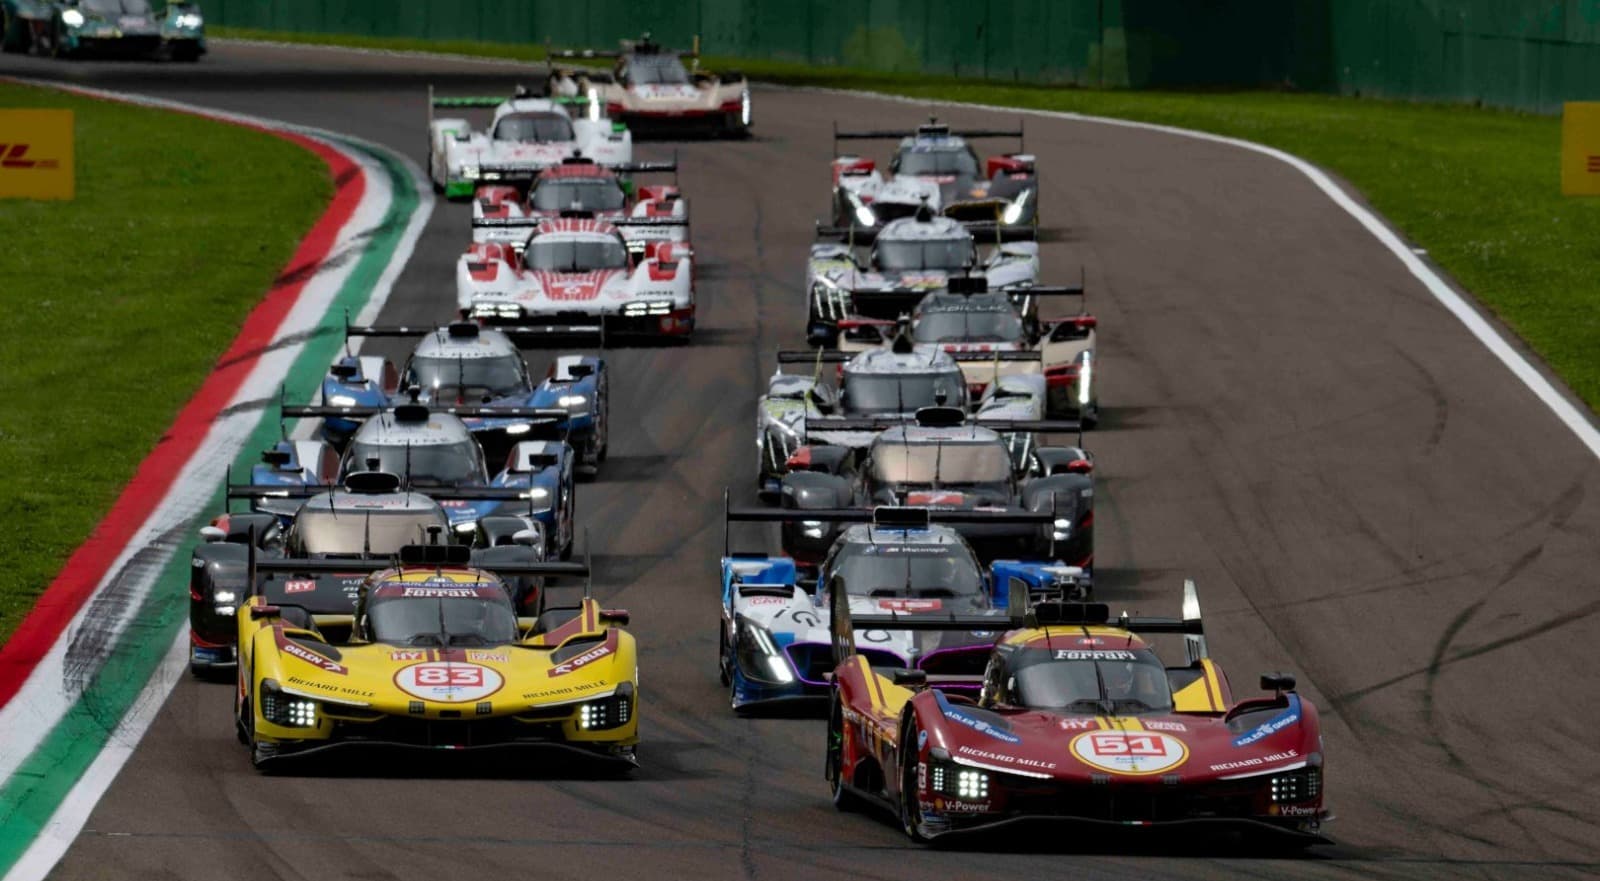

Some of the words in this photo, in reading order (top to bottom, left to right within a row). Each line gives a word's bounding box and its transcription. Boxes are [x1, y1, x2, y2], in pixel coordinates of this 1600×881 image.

[287, 581, 314, 591] HY
[402, 588, 479, 597] Ferrari
[284, 645, 323, 665] ORLEN
[392, 651, 421, 660] HY
[573, 647, 610, 667] ORLEN
[1054, 650, 1136, 659] Ferrari
[418, 668, 481, 684] 83
[288, 676, 339, 692] RICHARD
[341, 687, 375, 698] MILLE
[522, 688, 573, 700] RICHARD
[574, 679, 609, 693] MILLE
[944, 711, 975, 727] ADLER
[985, 728, 1019, 743] GROUP
[1059, 719, 1089, 730] HY
[1094, 736, 1164, 755] 51
[1237, 731, 1266, 747] ADLER
[960, 745, 1015, 763] RICHARD
[1016, 758, 1057, 769] MILLE
[1210, 758, 1262, 772] RICHARD
[1263, 749, 1299, 763] MILLE
[944, 801, 990, 811] V-Power
